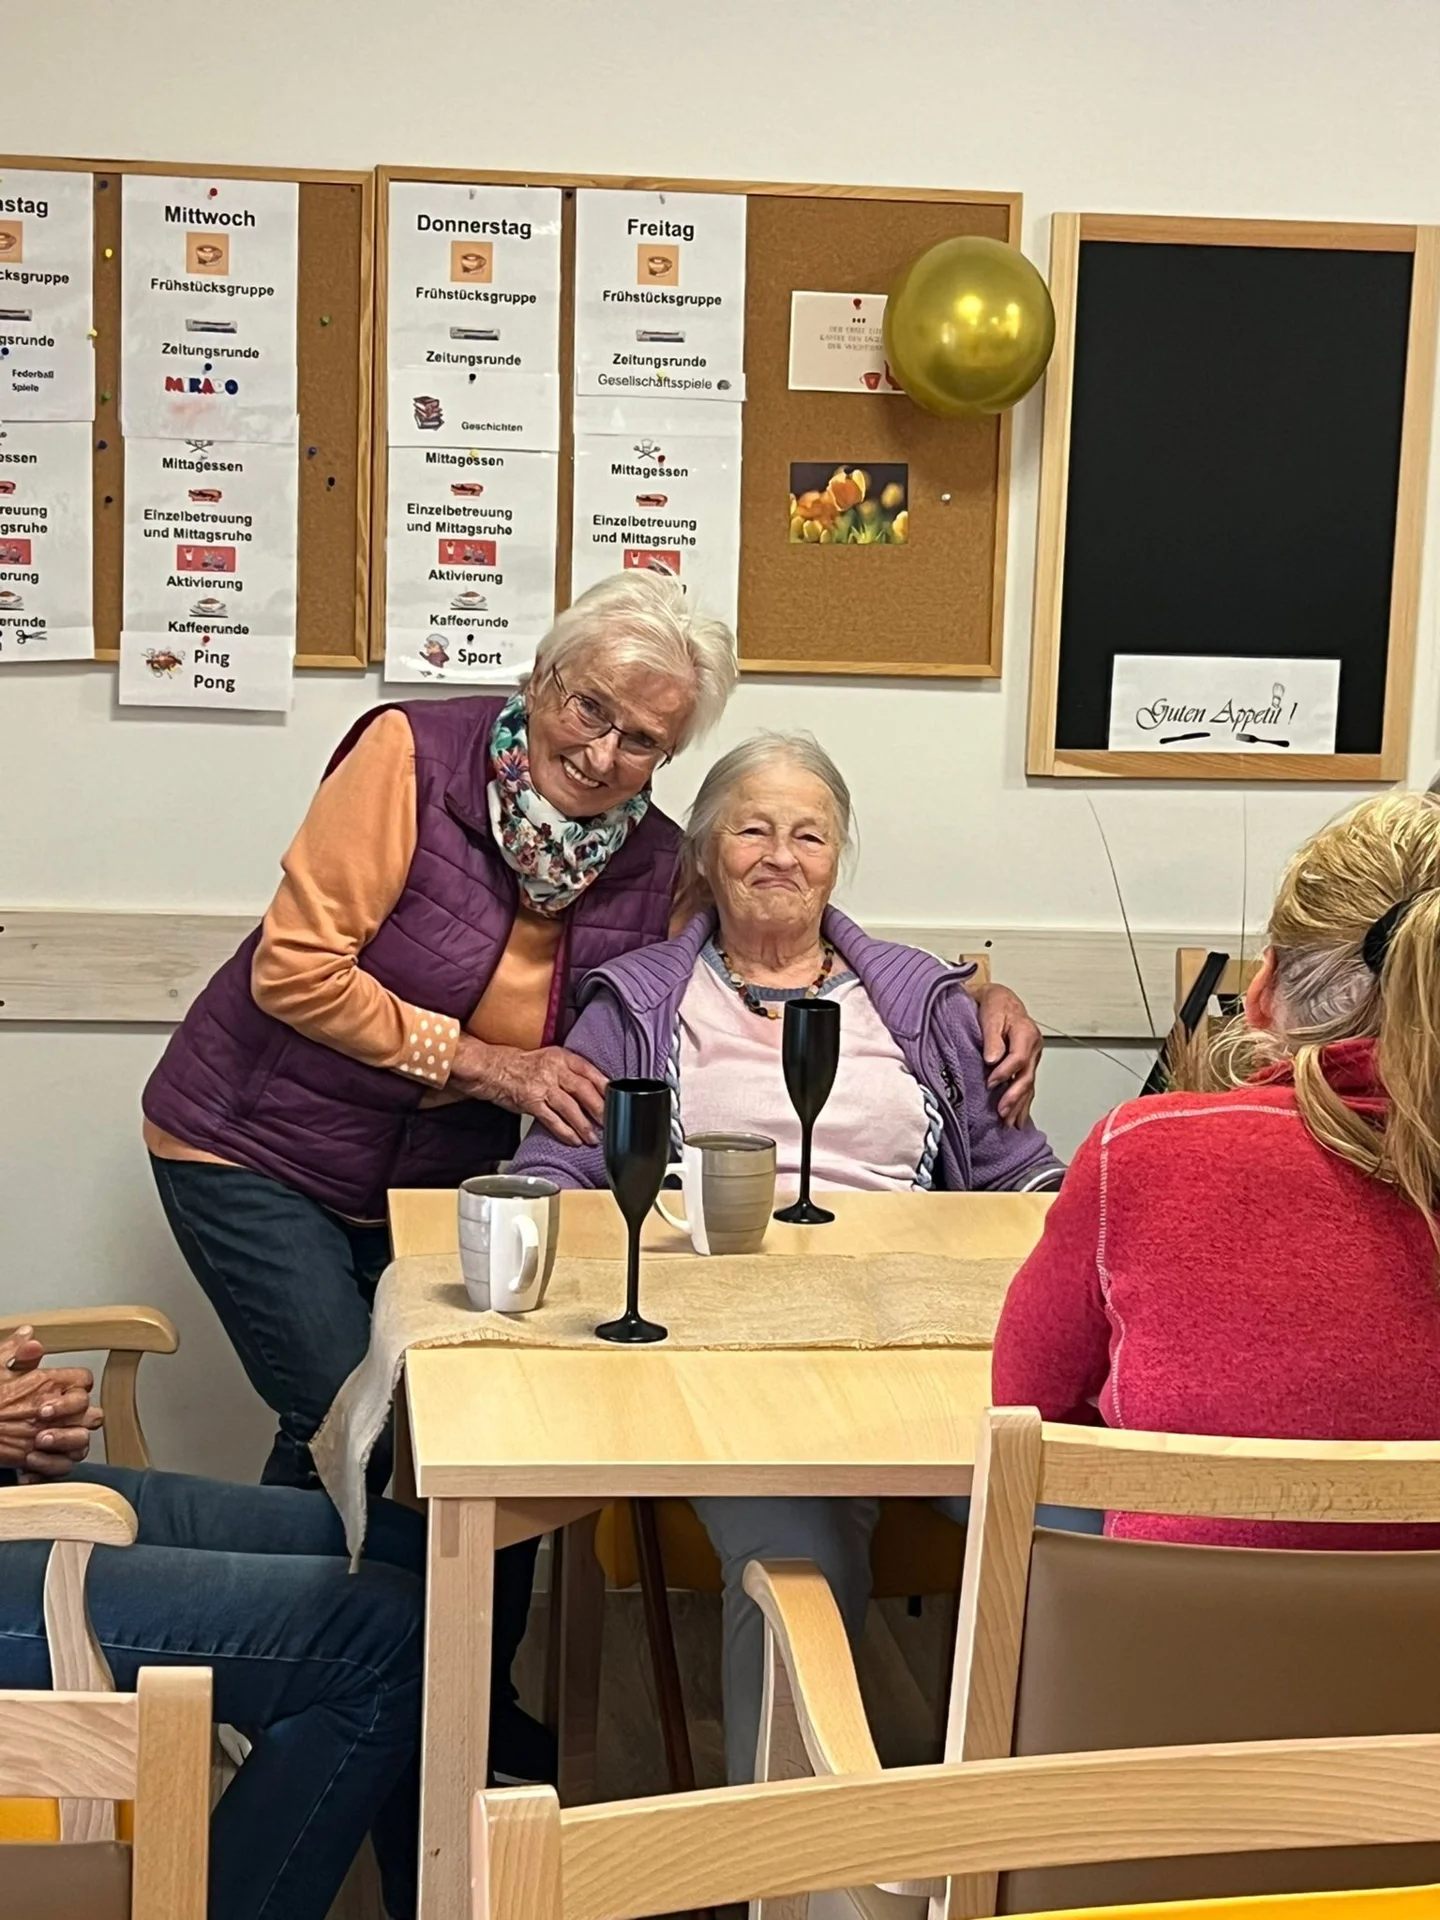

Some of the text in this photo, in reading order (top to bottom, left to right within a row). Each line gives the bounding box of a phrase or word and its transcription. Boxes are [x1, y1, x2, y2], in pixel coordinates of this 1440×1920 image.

[165, 206, 256, 227] Mittwoch
[418, 214, 532, 239] Donnerstag
[628, 219, 695, 241] Freitag
[151, 278, 275, 297] Frühstücksgruppe
[416, 287, 537, 305] Frühstücksgruppe
[603, 290, 722, 307] Frühstücksgruppe
[162, 343, 260, 359] Zeitungsrunde
[426, 351, 522, 367] Zeitungsrunde
[613, 353, 707, 369] Zeitungsrunde
[12, 369, 54, 379] Federball
[12, 383, 39, 393] Spiele
[461, 421, 523, 432] Geschichten
[163, 457, 243, 473] Mittagessen
[426, 452, 504, 467] Mittagessen
[611, 464, 688, 478] Mittagessen
[144, 509, 252, 526] Einzelbetreuung
[407, 503, 512, 520] Einzelbetreuung
[407, 521, 512, 536] und Mittagsruhe
[593, 514, 697, 530] Einzelbetreuung
[144, 527, 252, 542] und Mittagsruhe
[593, 532, 697, 546] und Mittagsruhe
[167, 576, 243, 591] Aktivierung
[428, 569, 503, 584] Aktivierung
[168, 621, 249, 635] Kaffeerunde
[430, 614, 509, 628] Kaffeerunde
[194, 650, 230, 668] Ping
[458, 649, 502, 666] Sport
[194, 675, 235, 693] Pong
[1136, 698, 1207, 730] Guten
